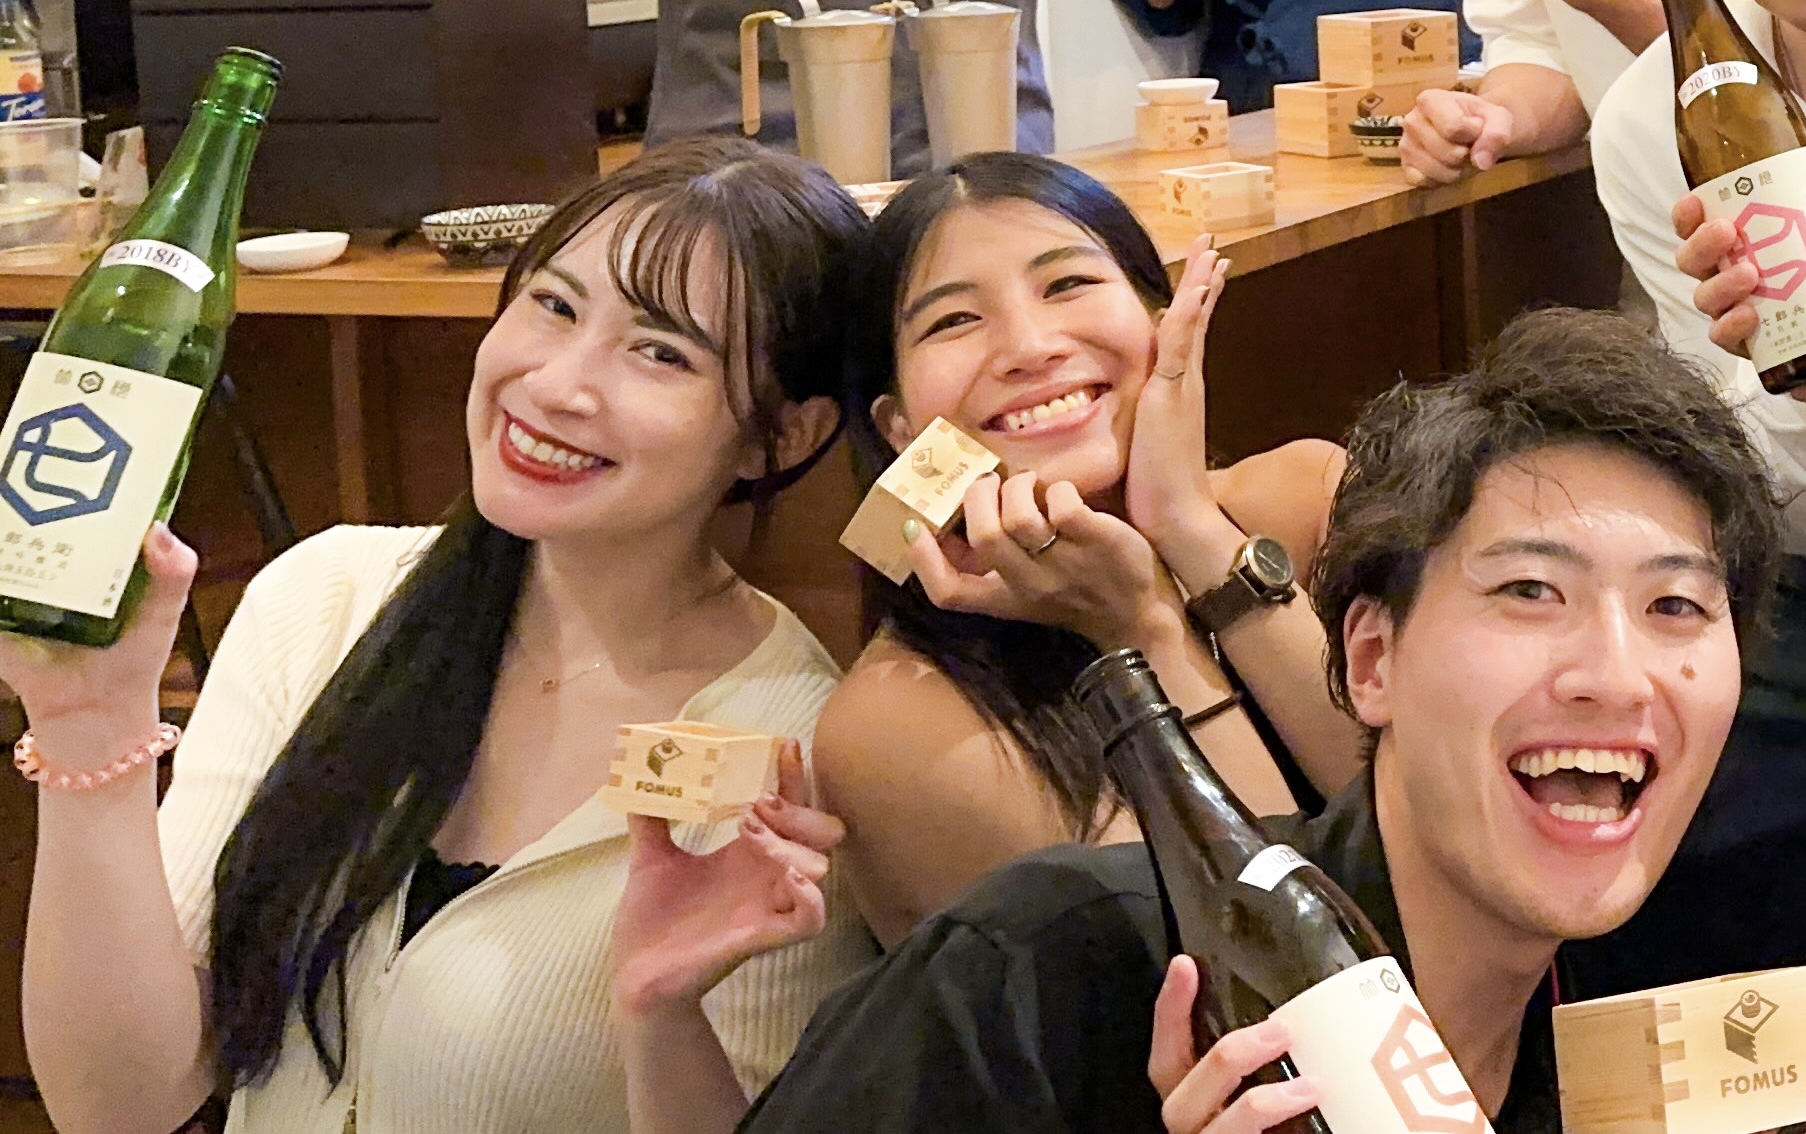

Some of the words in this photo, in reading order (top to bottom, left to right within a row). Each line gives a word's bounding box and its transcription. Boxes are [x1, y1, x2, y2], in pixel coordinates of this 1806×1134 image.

[934, 461, 969, 497] FOMUS
[635, 780, 683, 798] FOMUS
[1720, 1064, 1798, 1098] FOMUS
